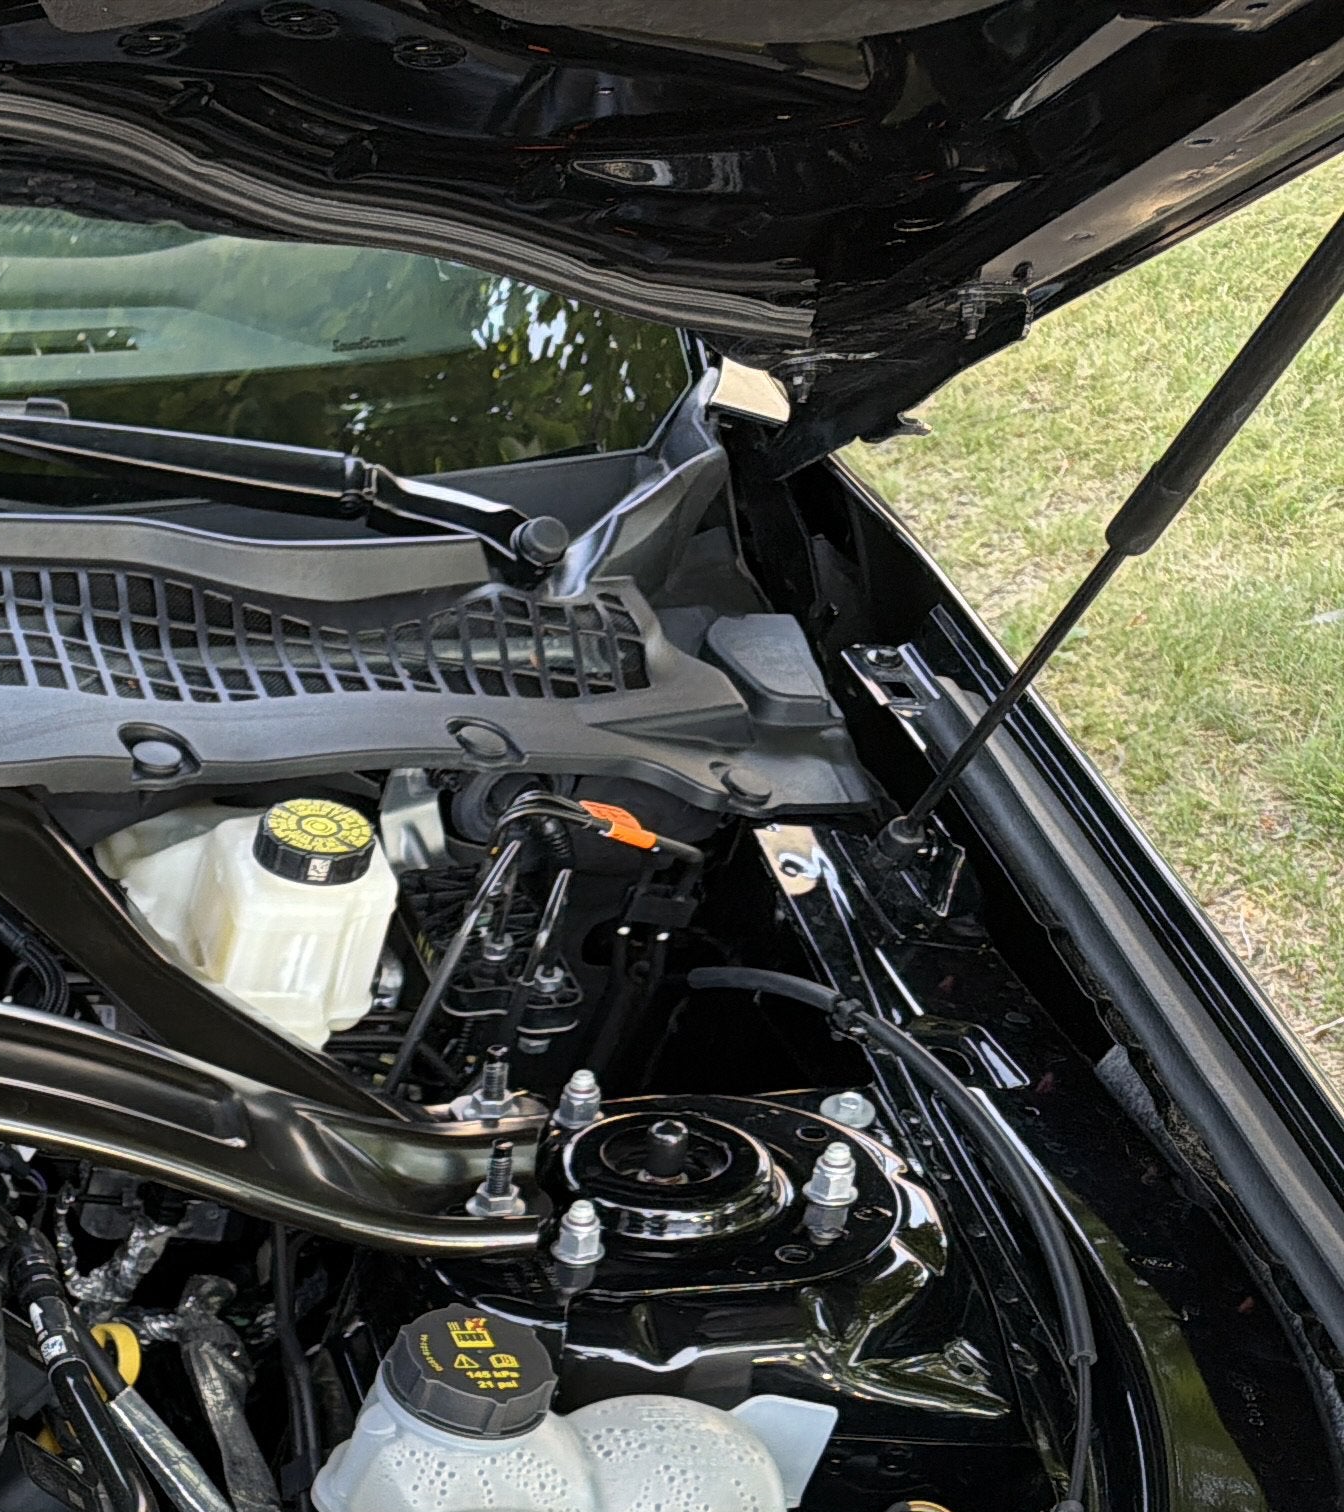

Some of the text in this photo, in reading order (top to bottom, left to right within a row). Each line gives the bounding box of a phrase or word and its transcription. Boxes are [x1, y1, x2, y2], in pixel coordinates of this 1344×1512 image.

[466, 1370, 520, 1380] 145 kPa
[477, 1380, 518, 1390] 21 psi
